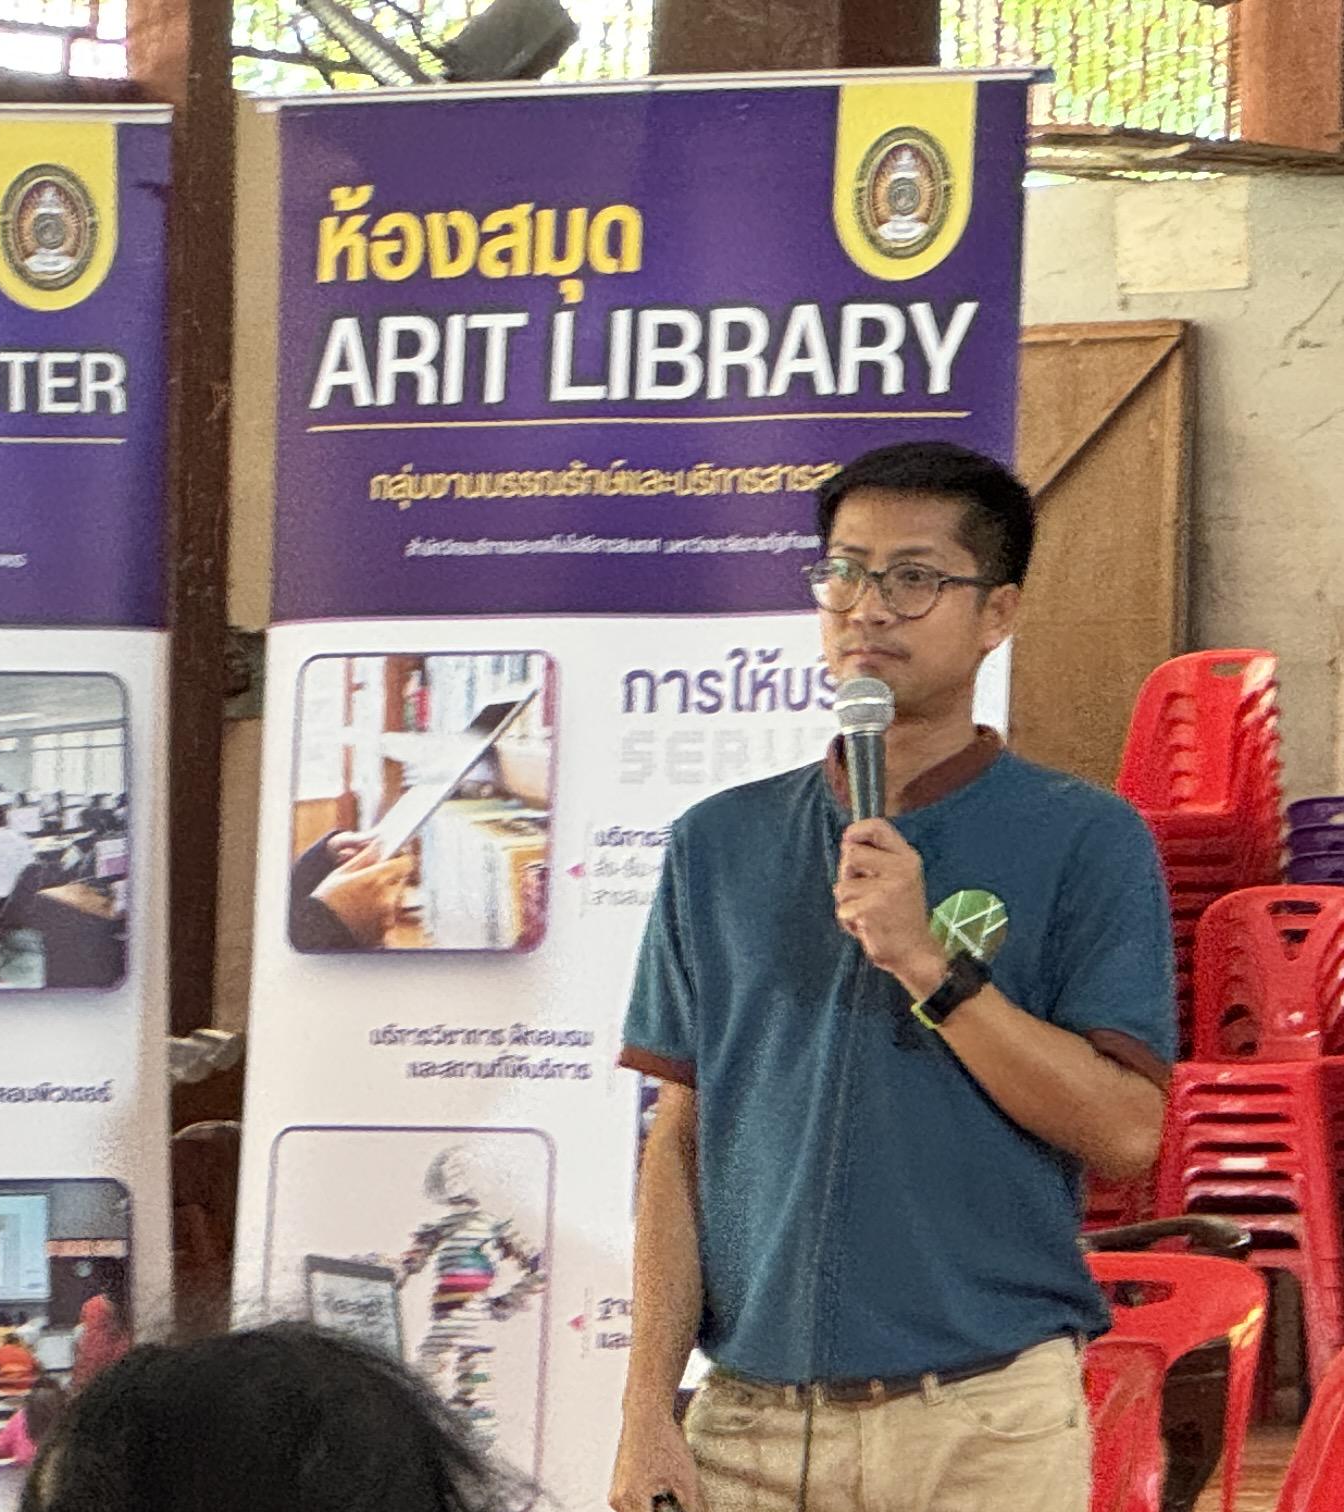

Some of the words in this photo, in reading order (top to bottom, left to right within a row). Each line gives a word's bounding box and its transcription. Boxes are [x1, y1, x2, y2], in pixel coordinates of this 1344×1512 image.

[316, 185, 643, 303] ห้องสมุด
[309, 311, 529, 409] ARIT
[550, 300, 979, 402] LIBRARY
[622, 647, 838, 714] การให้บร
